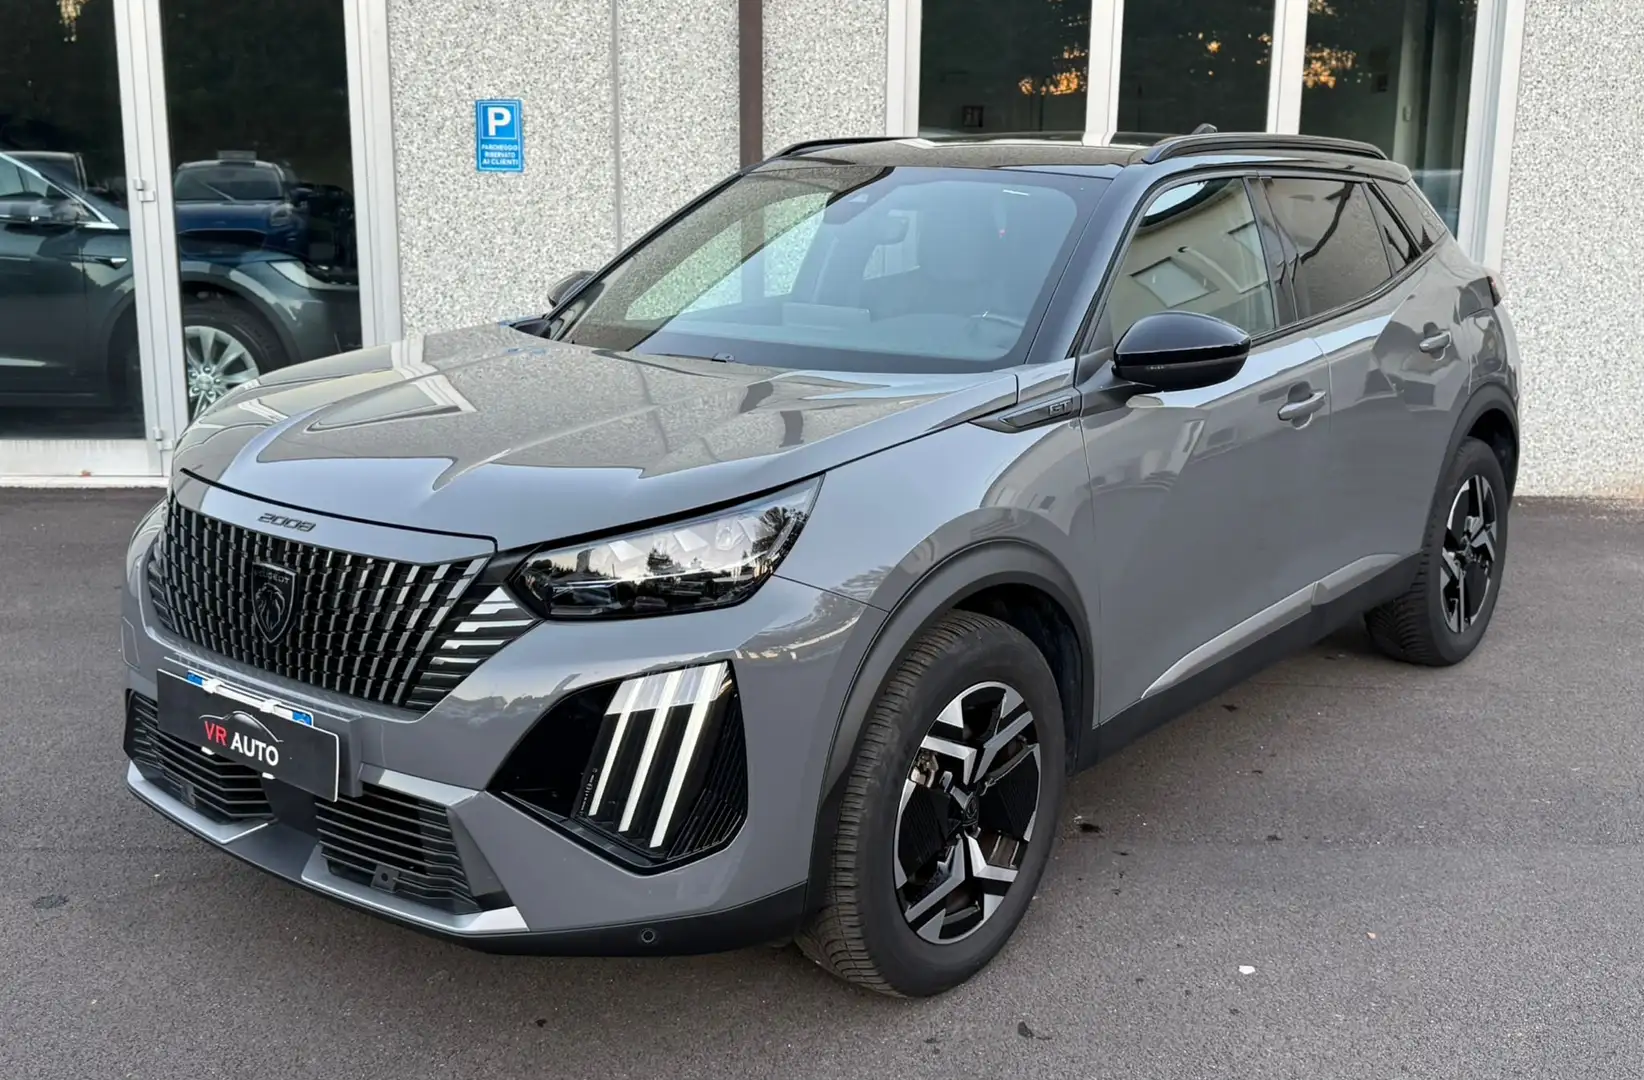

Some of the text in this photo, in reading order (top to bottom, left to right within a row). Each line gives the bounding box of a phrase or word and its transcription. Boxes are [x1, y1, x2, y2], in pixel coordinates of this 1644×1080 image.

[488, 106, 511, 136] P
[491, 158, 519, 166] CLIENTI
[1049, 401, 1070, 415] GT
[258, 512, 317, 532] 2008
[204, 720, 280, 767] VR AUTO
